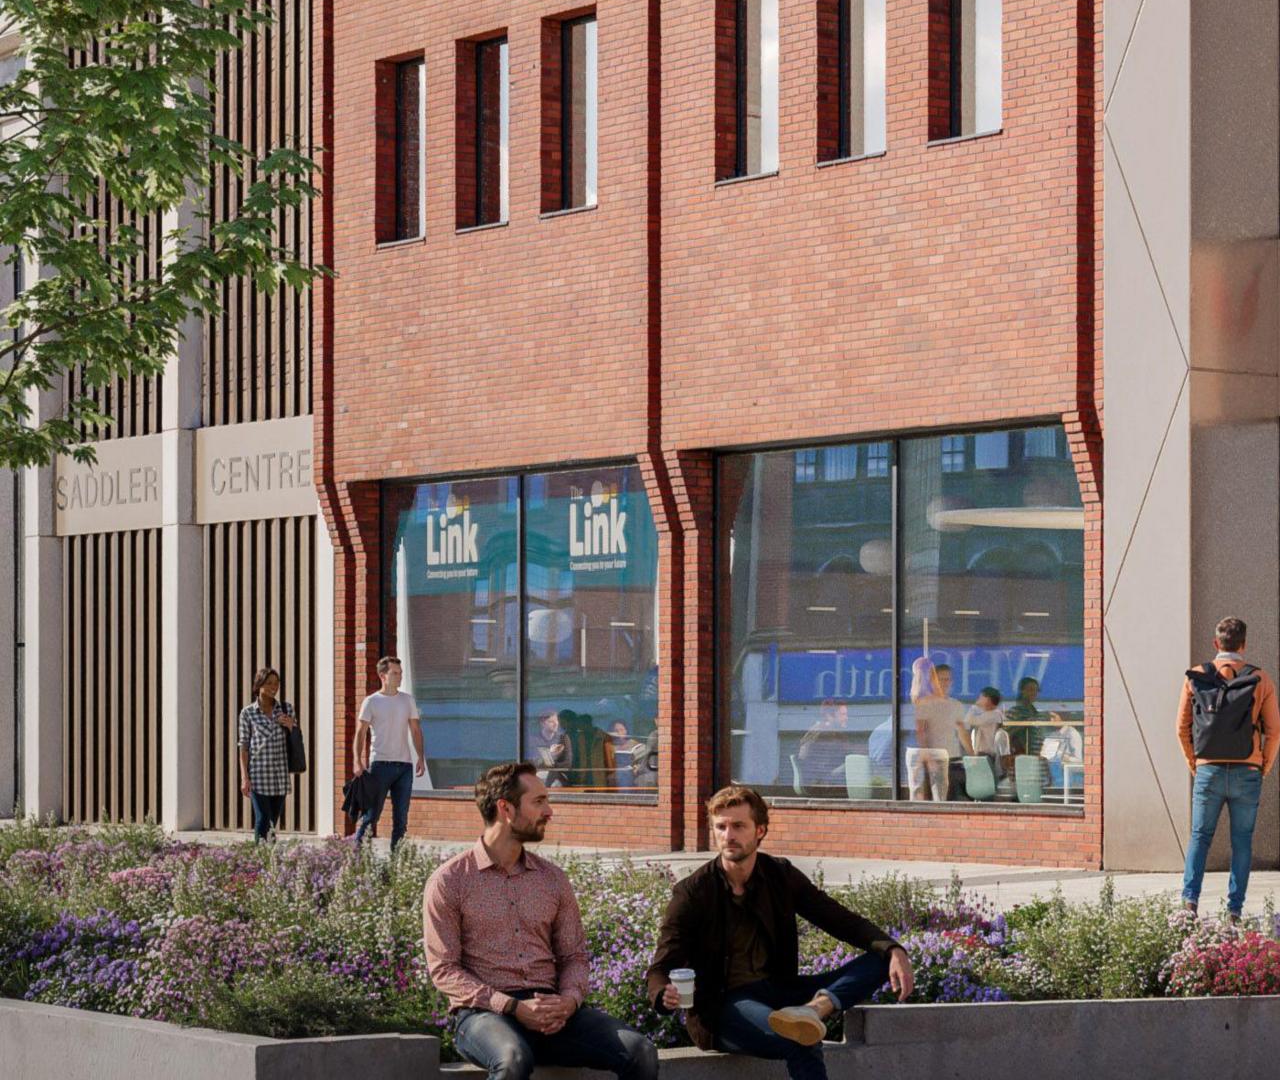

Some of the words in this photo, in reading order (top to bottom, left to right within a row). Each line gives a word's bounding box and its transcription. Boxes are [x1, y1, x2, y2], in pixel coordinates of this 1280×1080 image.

[56, 464, 159, 511] SADDLER
[210, 448, 311, 496] CENTRE
[426, 510, 479, 566] Link
[569, 498, 627, 557] Link
